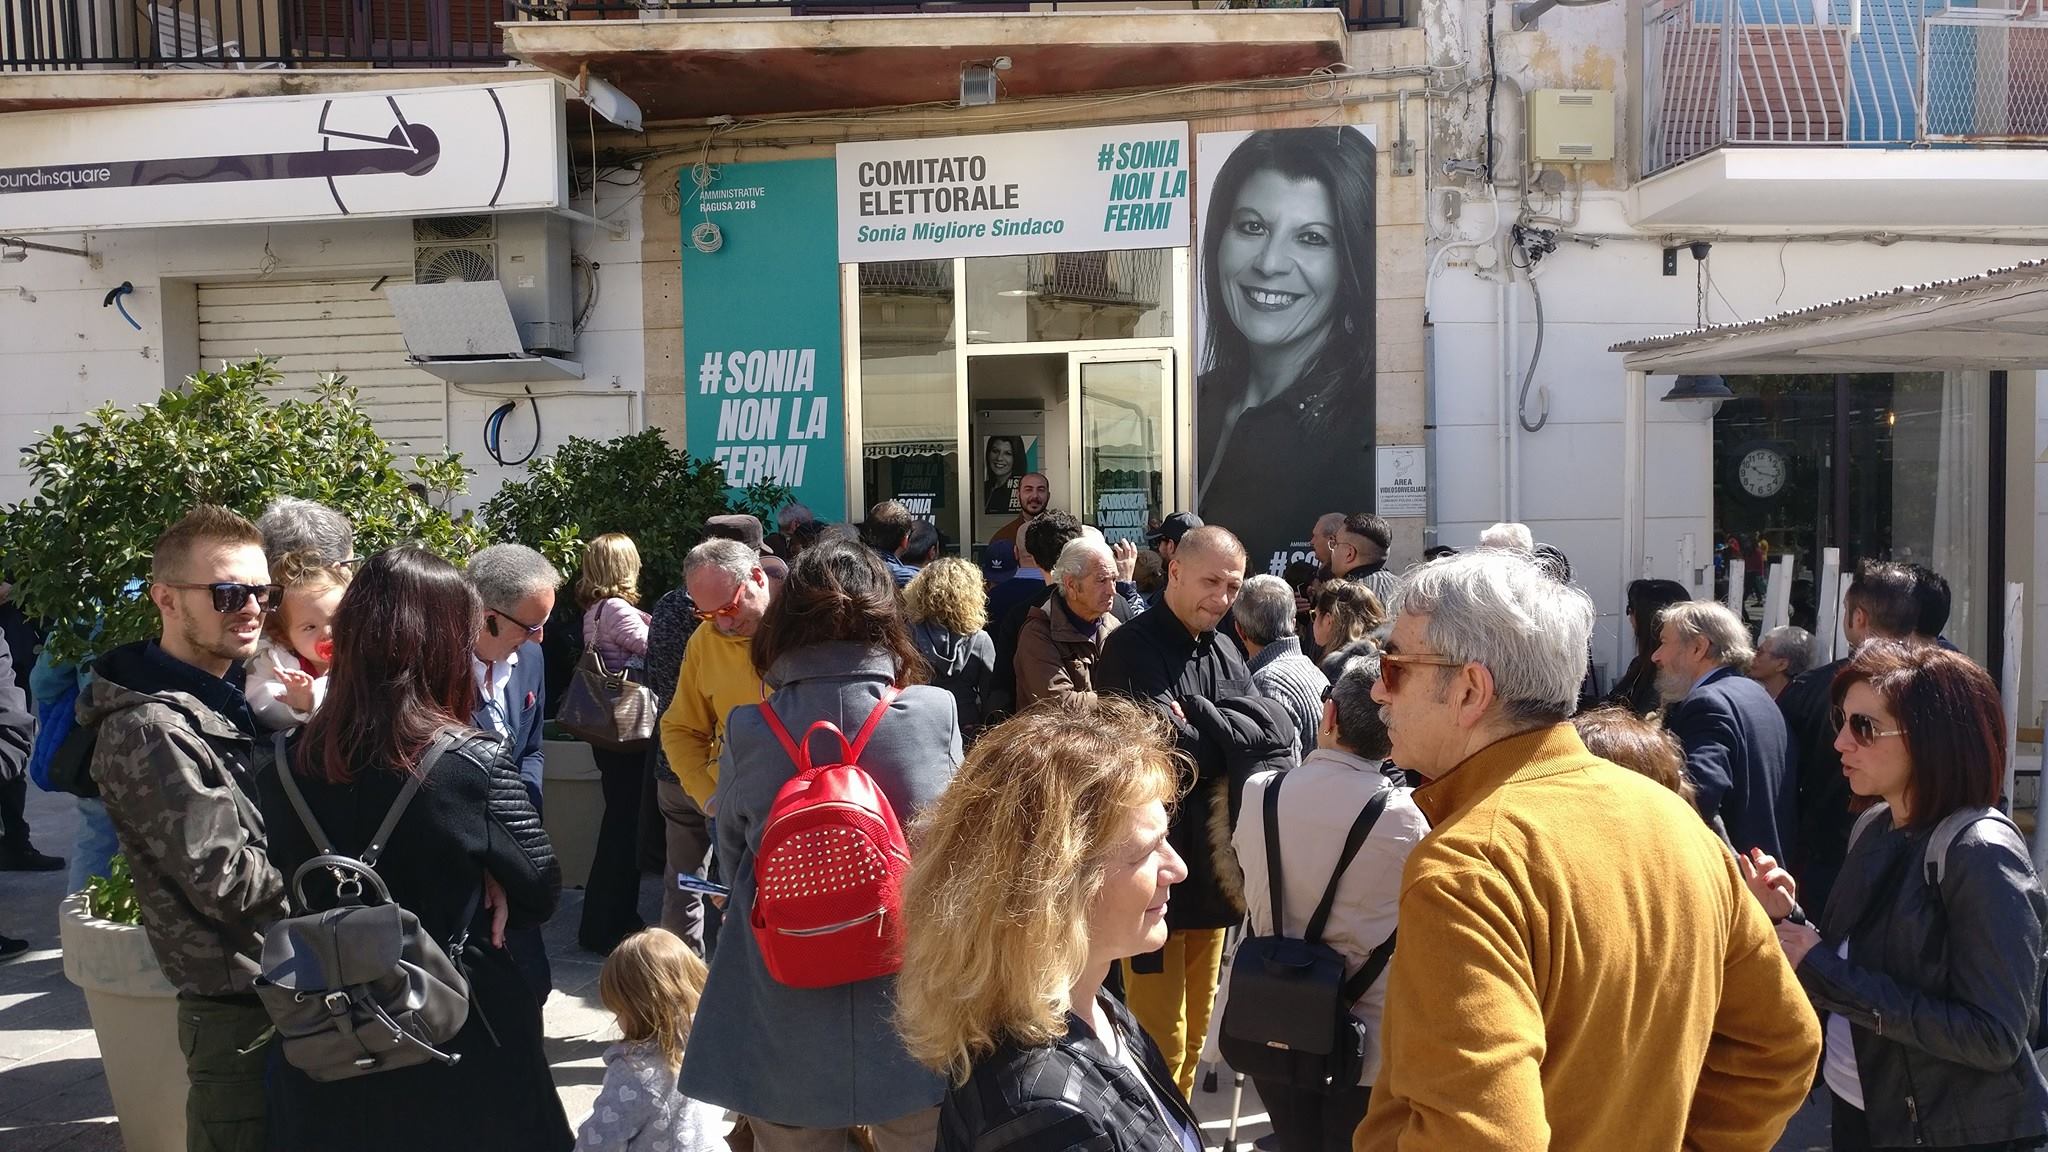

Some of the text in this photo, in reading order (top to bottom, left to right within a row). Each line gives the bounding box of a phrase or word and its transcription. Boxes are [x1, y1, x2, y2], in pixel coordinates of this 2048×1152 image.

[1098, 139, 1180, 171] #SONIA
[858, 155, 987, 188] COMITATO
[1109, 170, 1188, 201] NON LA
[700, 187, 765, 200] AMMINISTRATIVE
[700, 200, 756, 212] RAGUSA 2018
[859, 184, 1020, 217] ELETTORALE
[857, 217, 1065, 244] Sonia Migliore Sindaco
[1103, 202, 1173, 232] FERMI
[699, 349, 816, 394] #SONIA
[717, 397, 828, 441] NON LA
[714, 445, 808, 488] FERMI
[1394, 478, 1412, 486] AREA
